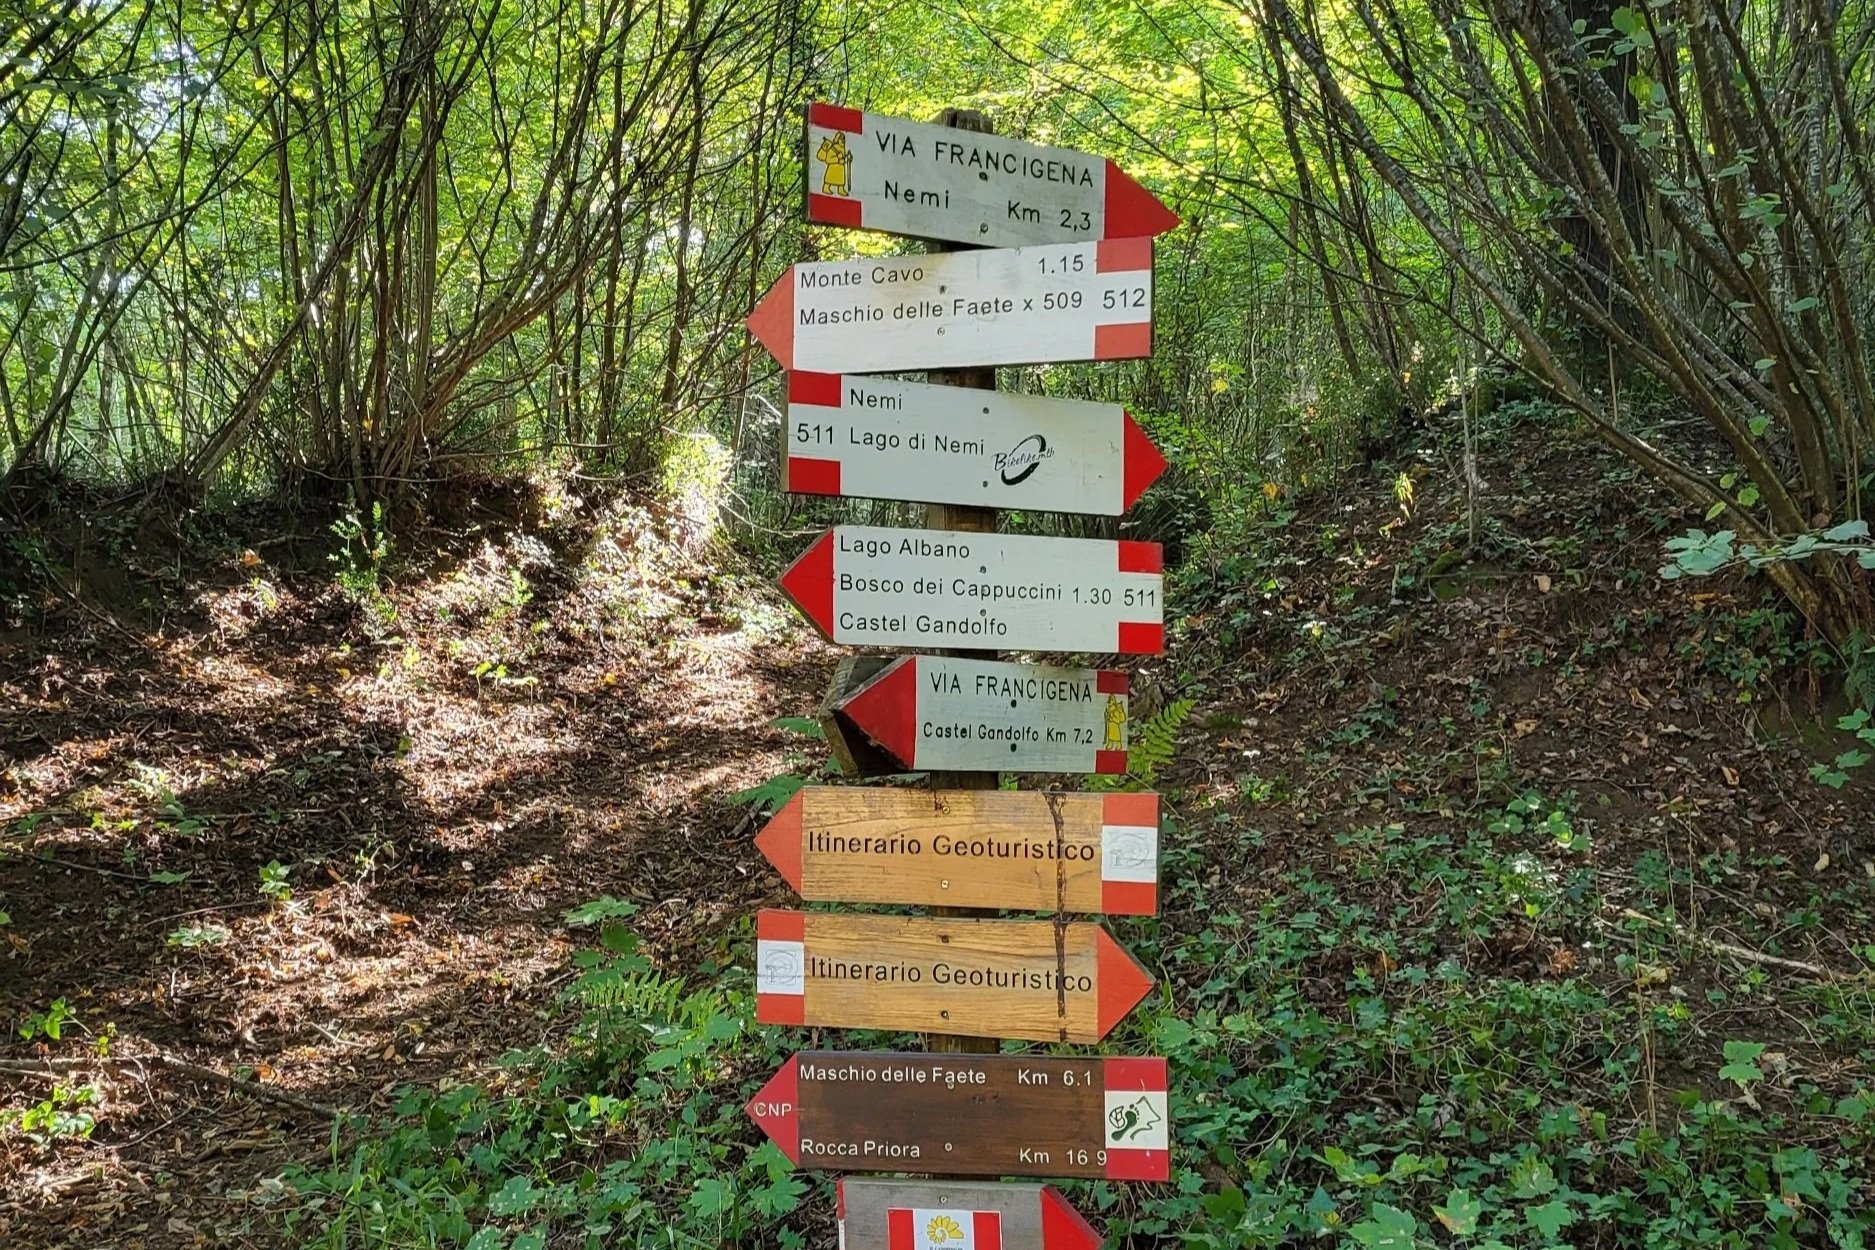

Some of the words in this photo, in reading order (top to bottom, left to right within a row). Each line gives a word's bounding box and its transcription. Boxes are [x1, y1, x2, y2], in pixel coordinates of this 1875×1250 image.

[875, 131, 916, 158] VIA
[934, 142, 1093, 188] FRANCIGENA
[884, 180, 950, 209] Nemi
[1007, 200, 1041, 224] Km
[1060, 209, 1091, 232] 2,3
[800, 270, 862, 289] Monte
[871, 266, 924, 284] Cavo
[1038, 254, 1084, 274] 1.15
[800, 304, 884, 325] Maschio
[893, 300, 943, 320] delle
[952, 297, 1013, 316] Faete
[1022, 299, 1034, 311] x
[1043, 291, 1083, 311] 509
[1102, 288, 1146, 310] 512
[850, 388, 902, 410] Nemi
[796, 423, 834, 445] 511
[850, 427, 900, 451] Lago
[908, 432, 925, 451] di
[934, 434, 985, 456] Nemi
[840, 535, 891, 557] Lago
[898, 539, 970, 559] Albano
[840, 573, 903, 593] Bosco
[913, 577, 943, 595] dei
[952, 579, 1062, 600] Cappuccini
[1072, 587, 1112, 605] 1.30
[1123, 588, 1155, 606] 511
[839, 612, 906, 632] Castel
[916, 615, 1007, 636] Gandolfo
[930, 672, 960, 694] VIA
[975, 675, 1092, 703] FRANCIGENA
[923, 722, 972, 739] Castel
[978, 724, 1039, 743] Gandolfo
[1046, 727, 1067, 743] Km
[1073, 728, 1094, 745] 7,2
[808, 831, 921, 855] Itinerario
[932, 835, 1095, 861] Geoturistico
[810, 956, 921, 982] Itinerario
[932, 963, 1092, 992] Geoturistico
[800, 1064, 876, 1083] Maschio
[881, 1066, 927, 1083] delle
[932, 1067, 986, 1085] Faete
[1018, 1069, 1048, 1086] Km
[1063, 1070, 1092, 1087] 6.1
[755, 1103, 792, 1117] CNP
[801, 1139, 858, 1156] Rocca
[864, 1141, 921, 1159] Priora
[1019, 1148, 1050, 1164] Km
